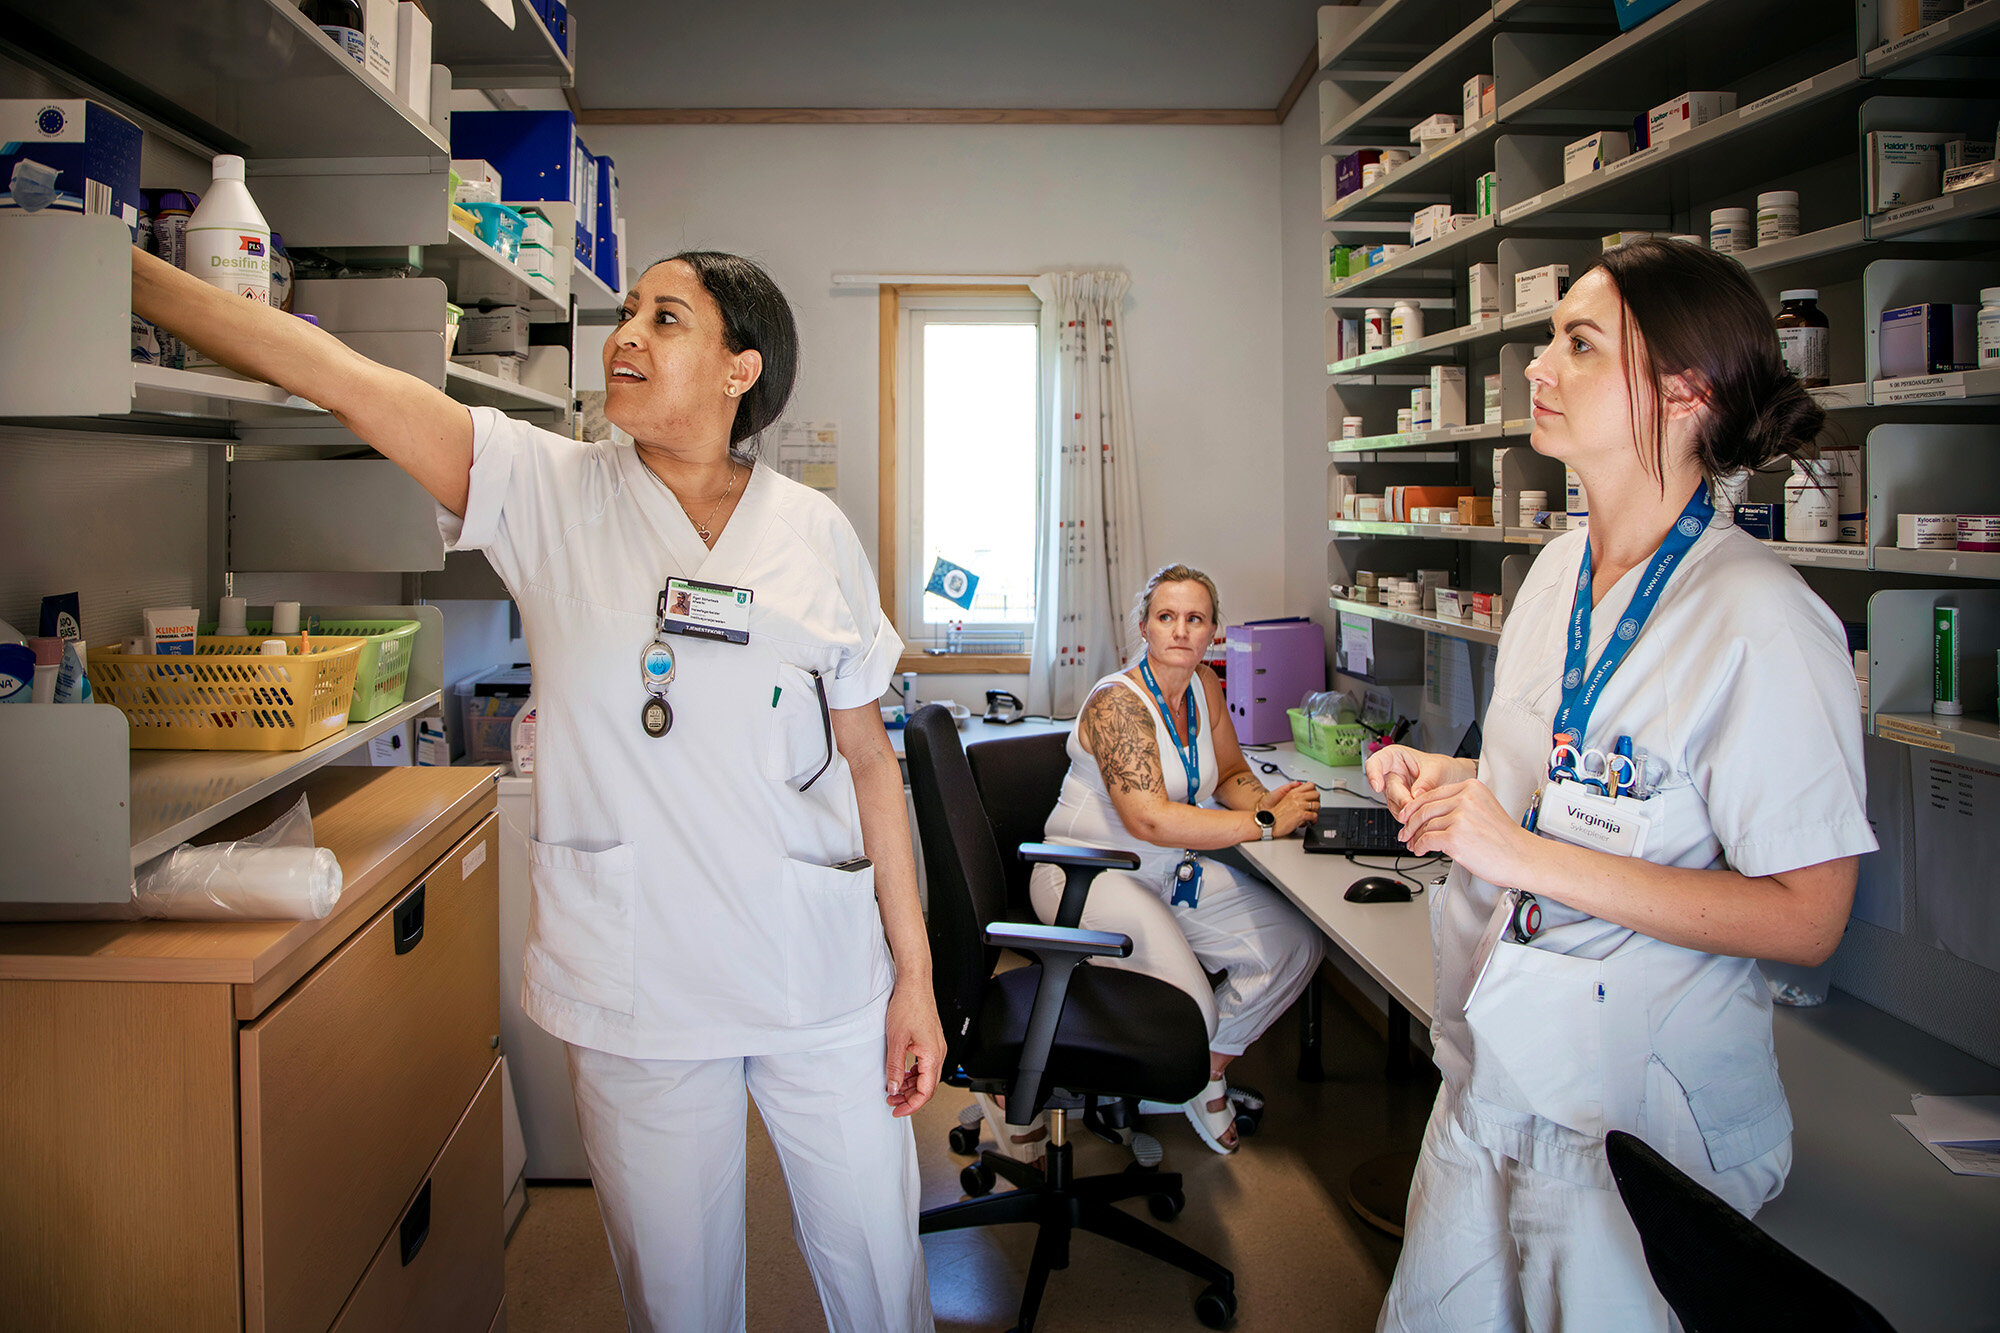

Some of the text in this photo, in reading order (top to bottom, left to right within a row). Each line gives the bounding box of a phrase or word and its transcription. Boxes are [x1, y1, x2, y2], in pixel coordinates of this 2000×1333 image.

[1650, 111, 1668, 124] Lipitor
[211, 256, 258, 269] Desifin
[1642, 554, 1674, 597] www.nsf.no
[60, 617, 71, 626] APO
[155, 625, 195, 634] KLINION
[1574, 607, 1584, 650] www.nsf.no
[60, 628, 76, 638] BASE
[1583, 660, 1613, 705] www.nsf.no
[1567, 804, 1620, 834] Virginija
[1570, 822, 1610, 842] Sykepleier
